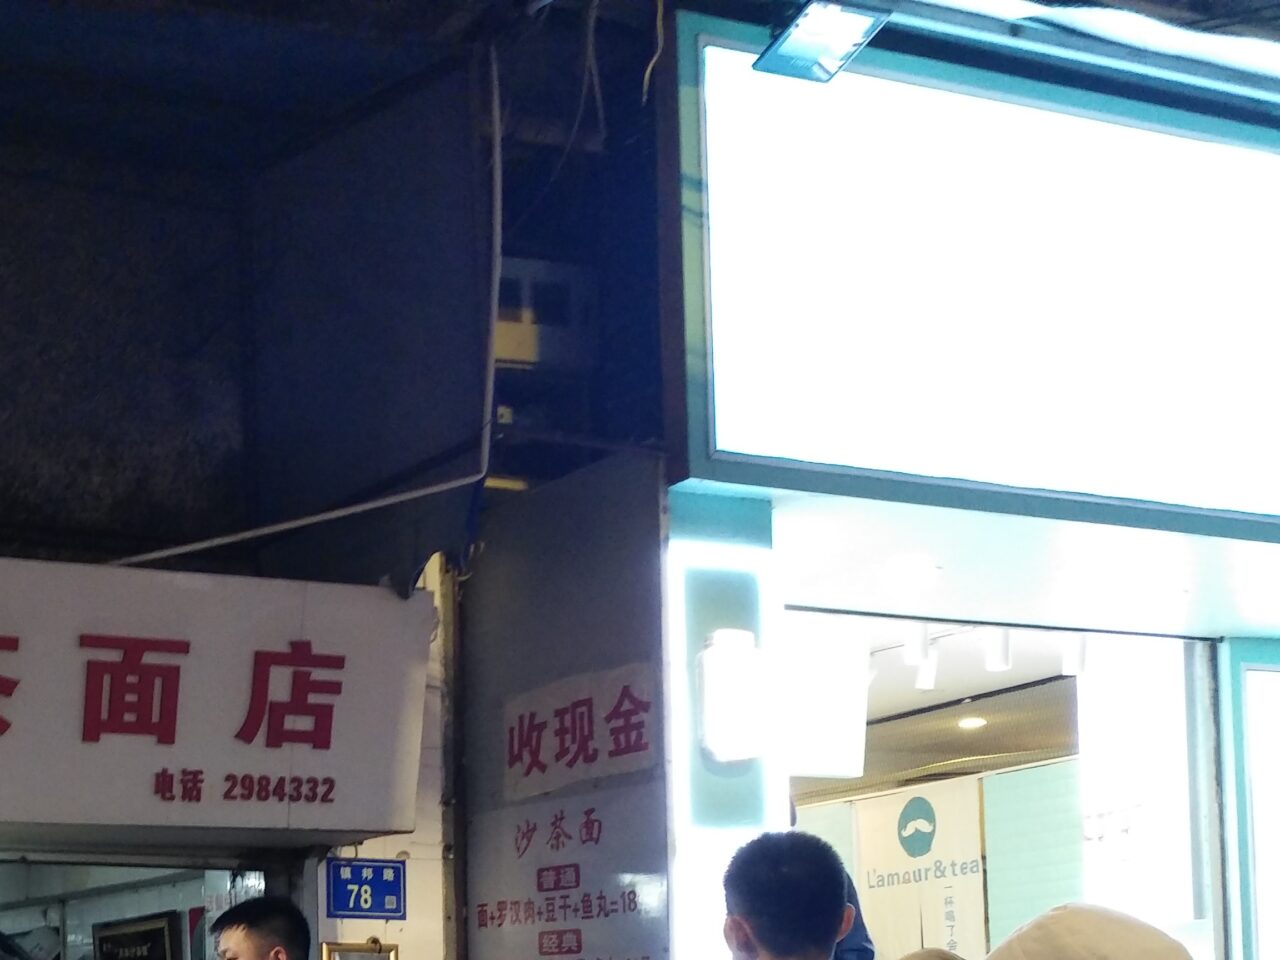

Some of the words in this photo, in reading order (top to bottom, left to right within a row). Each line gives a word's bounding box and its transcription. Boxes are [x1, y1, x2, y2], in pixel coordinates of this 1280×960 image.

[507, 685, 652, 778] 收现金
[153, 767, 205, 803] 电话
[222, 773, 337, 804] 2984332
[514, 808, 603, 860] 沙茶面
[346, 884, 373, 909] 78
[541, 932, 581, 954] 经典
